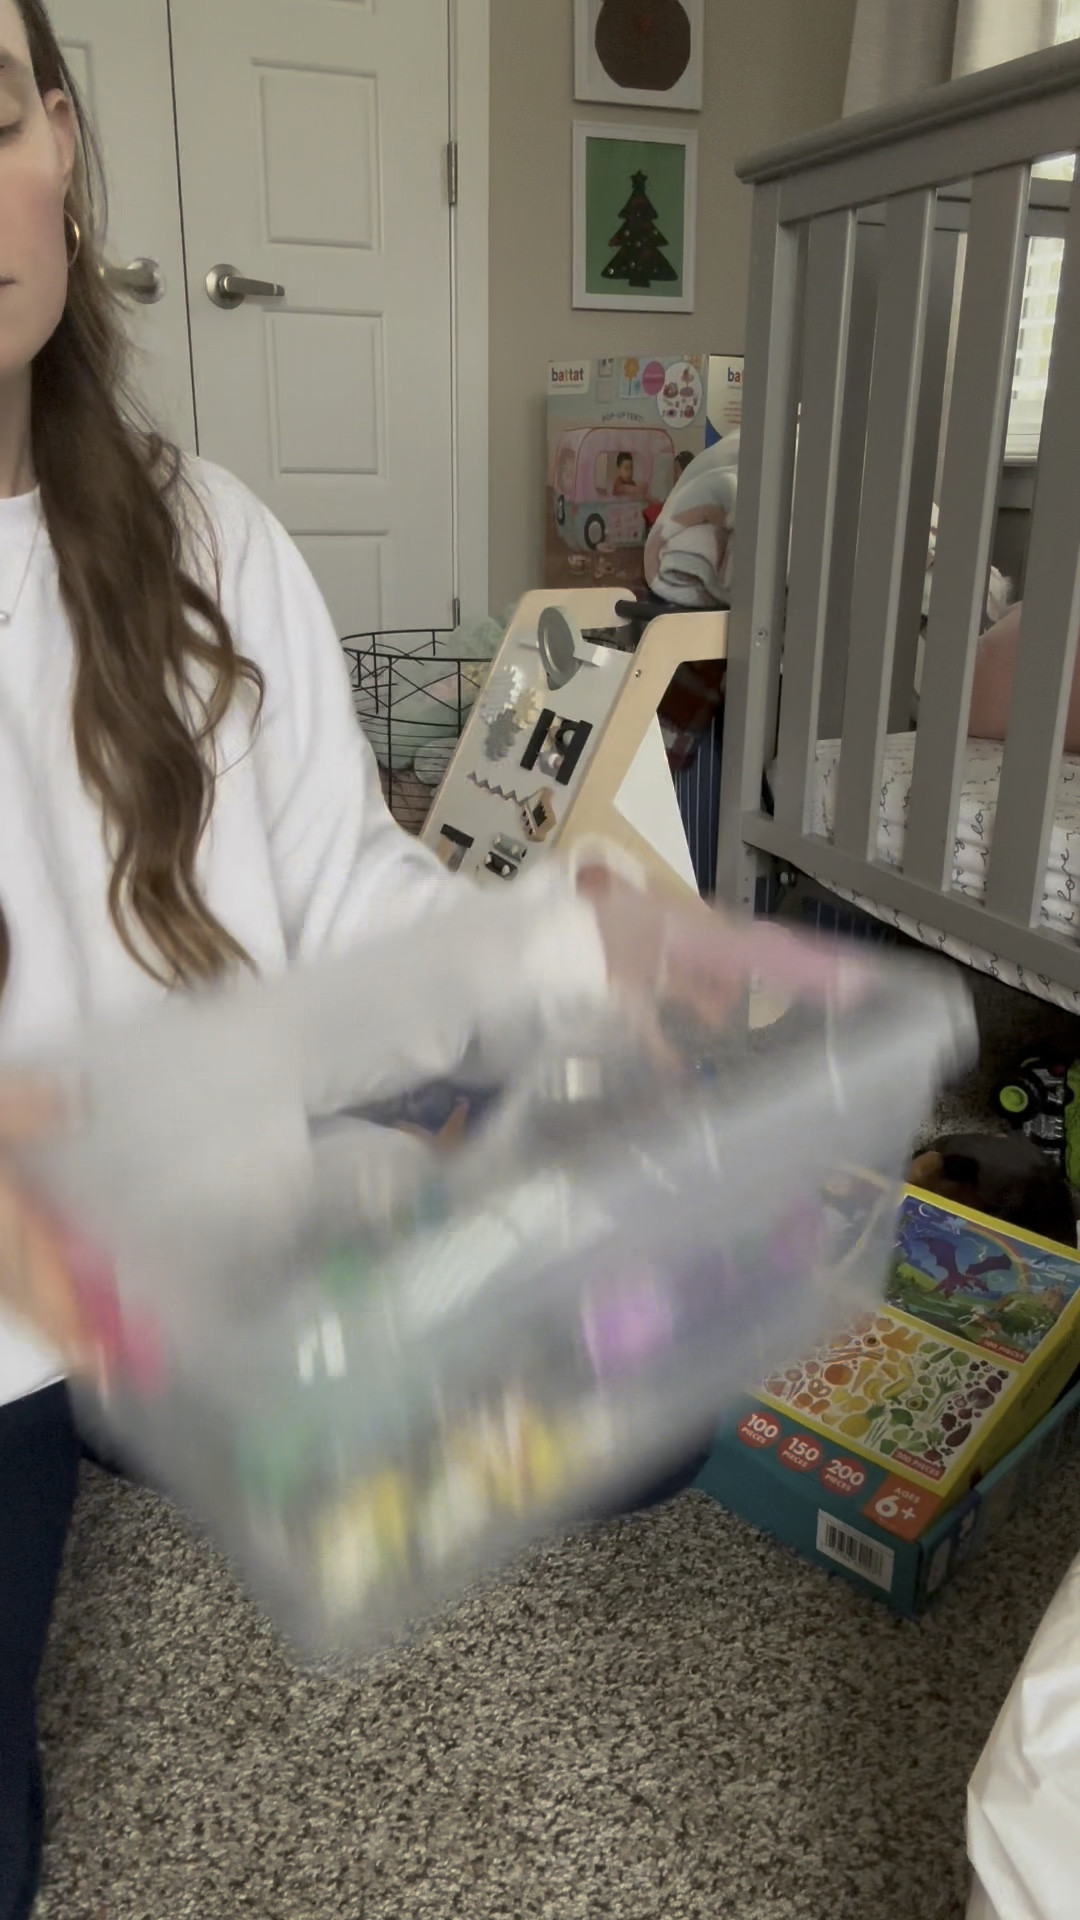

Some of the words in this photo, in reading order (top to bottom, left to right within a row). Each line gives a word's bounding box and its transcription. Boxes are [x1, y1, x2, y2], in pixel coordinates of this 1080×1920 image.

[551, 367, 584, 382] battat
[747, 1413, 779, 1438] 100
[740, 1426, 768, 1445] PIECES
[782, 1449, 809, 1468] PIECES
[788, 1437, 820, 1462] 150
[826, 1459, 865, 1486] 200
[910, 1458, 941, 1478] PIECES
[824, 1473, 852, 1492] PIECES
[894, 1487, 921, 1504] AGES
[875, 1494, 917, 1520] 6+
